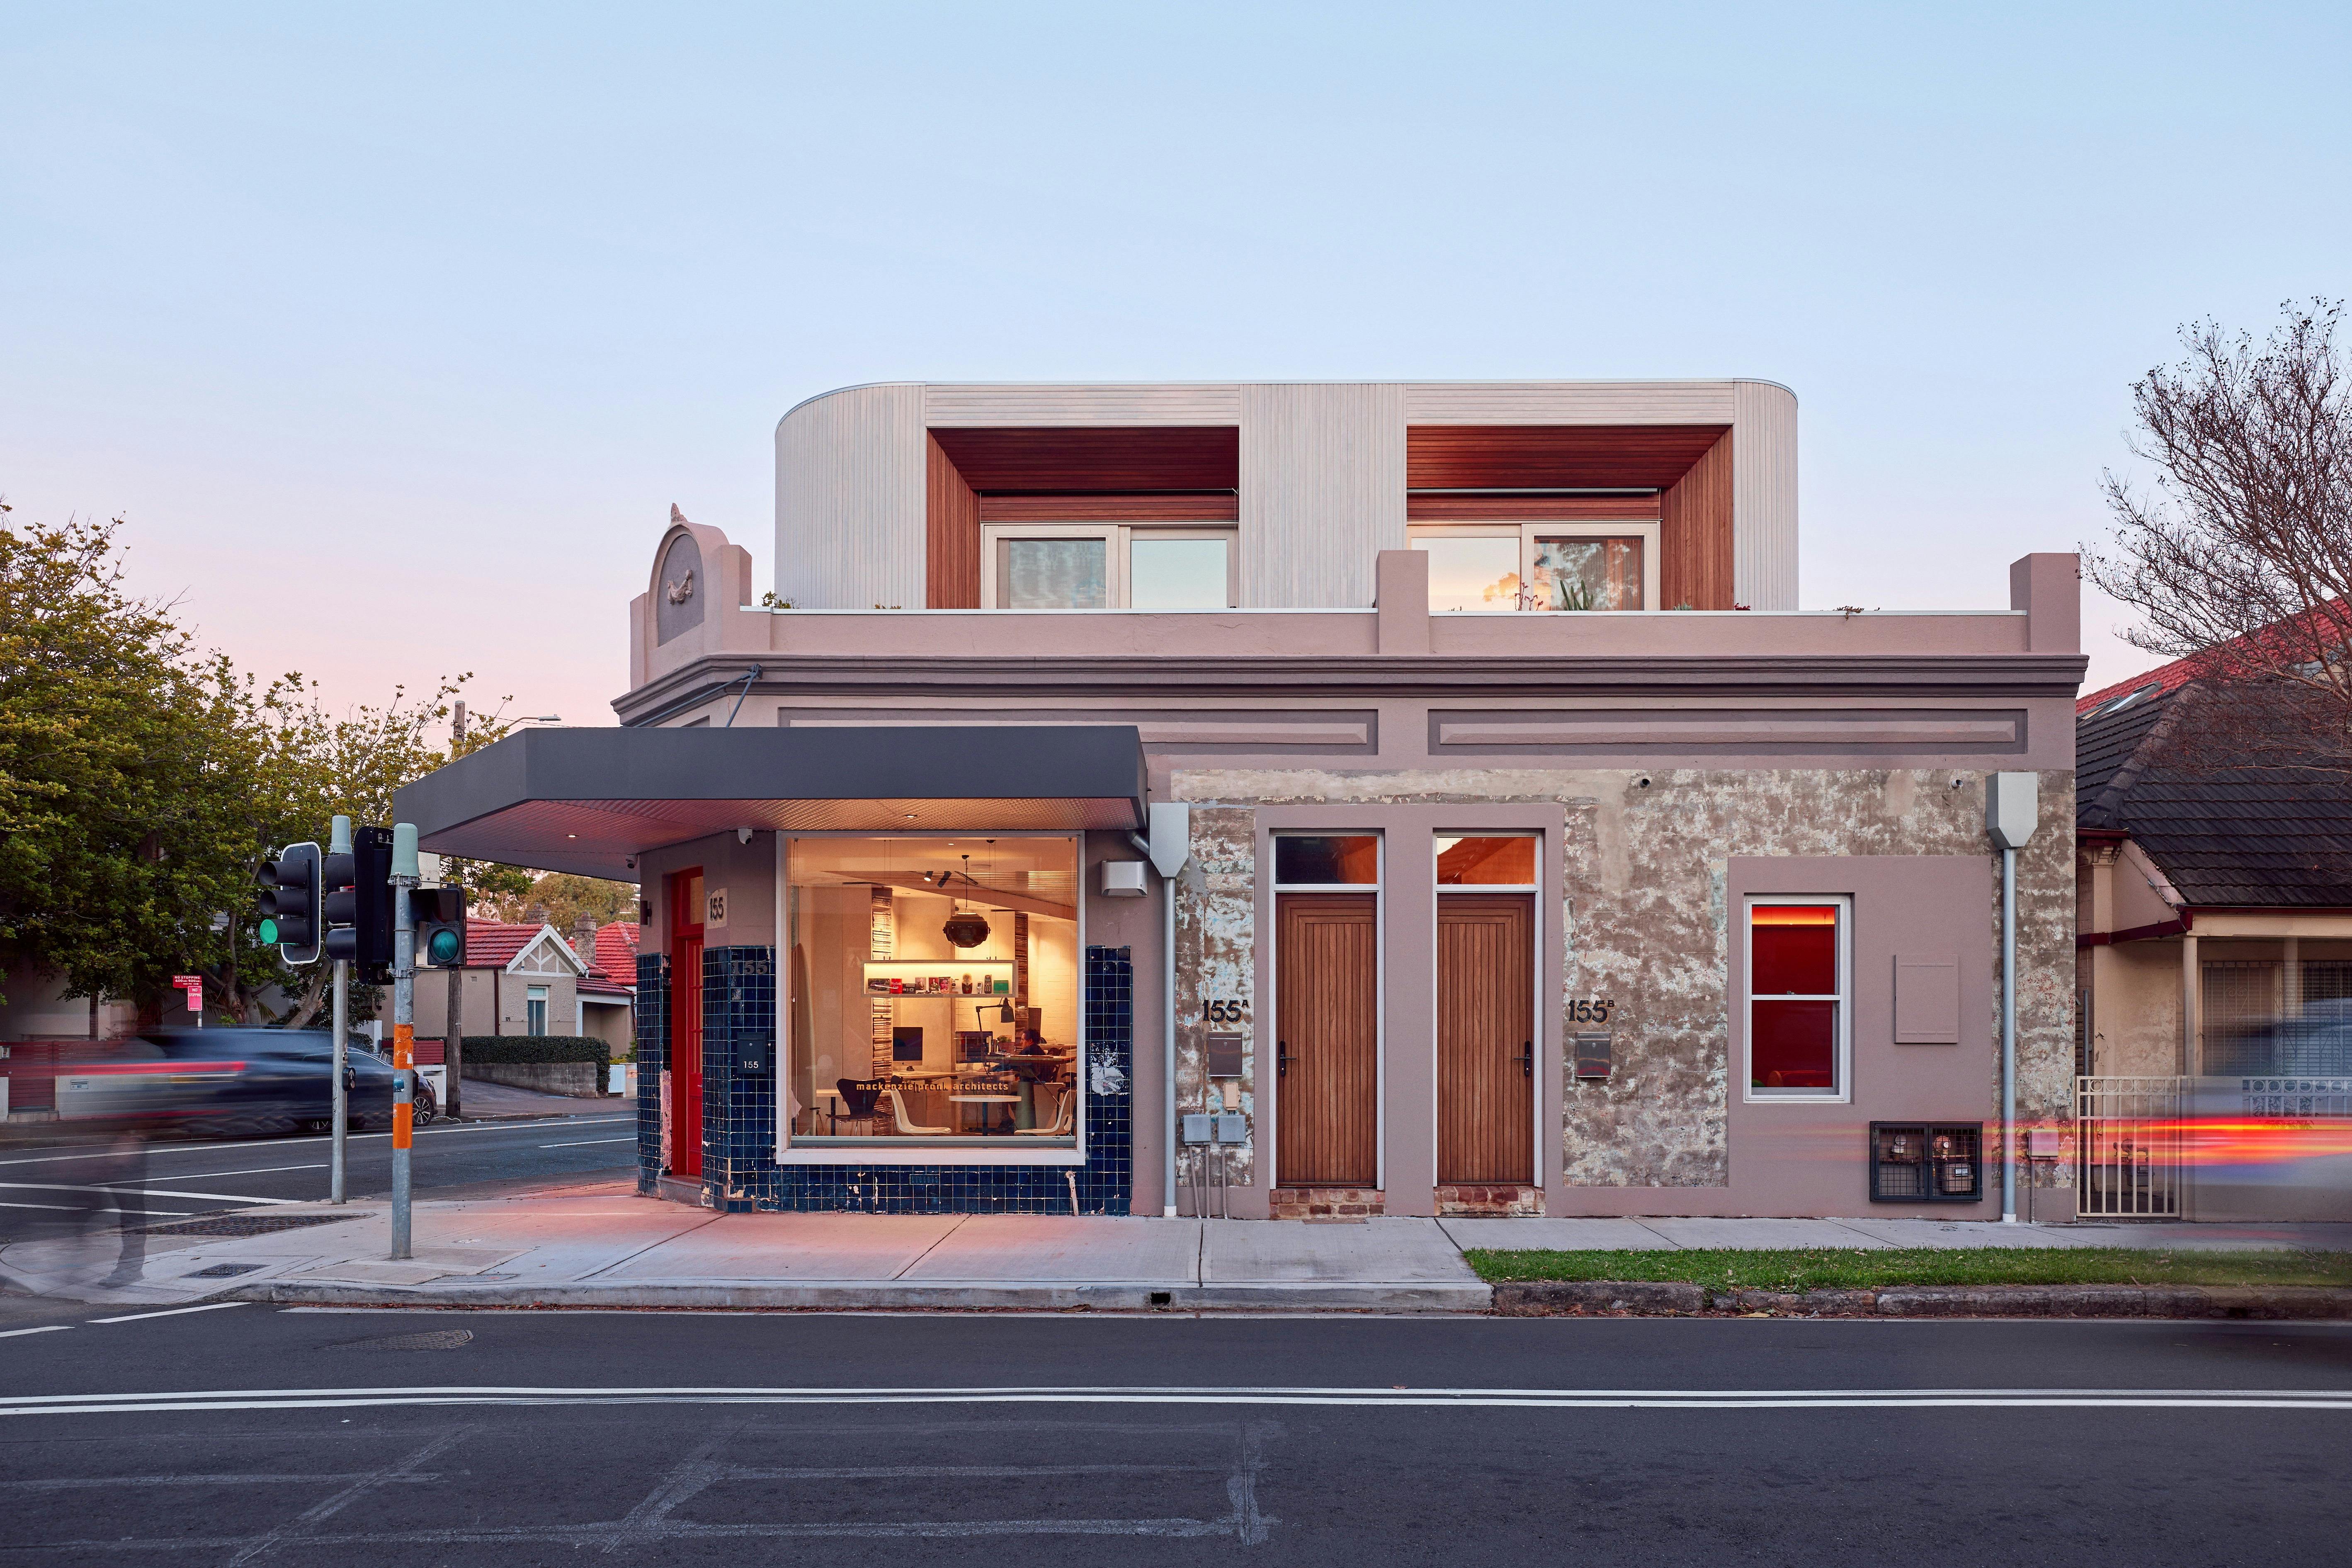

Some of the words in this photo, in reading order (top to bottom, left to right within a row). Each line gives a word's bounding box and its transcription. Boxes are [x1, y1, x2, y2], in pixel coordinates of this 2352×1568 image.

[710, 896, 724, 921] 155
[731, 960, 768, 975] 155
[952, 1082, 1009, 1090] architects
